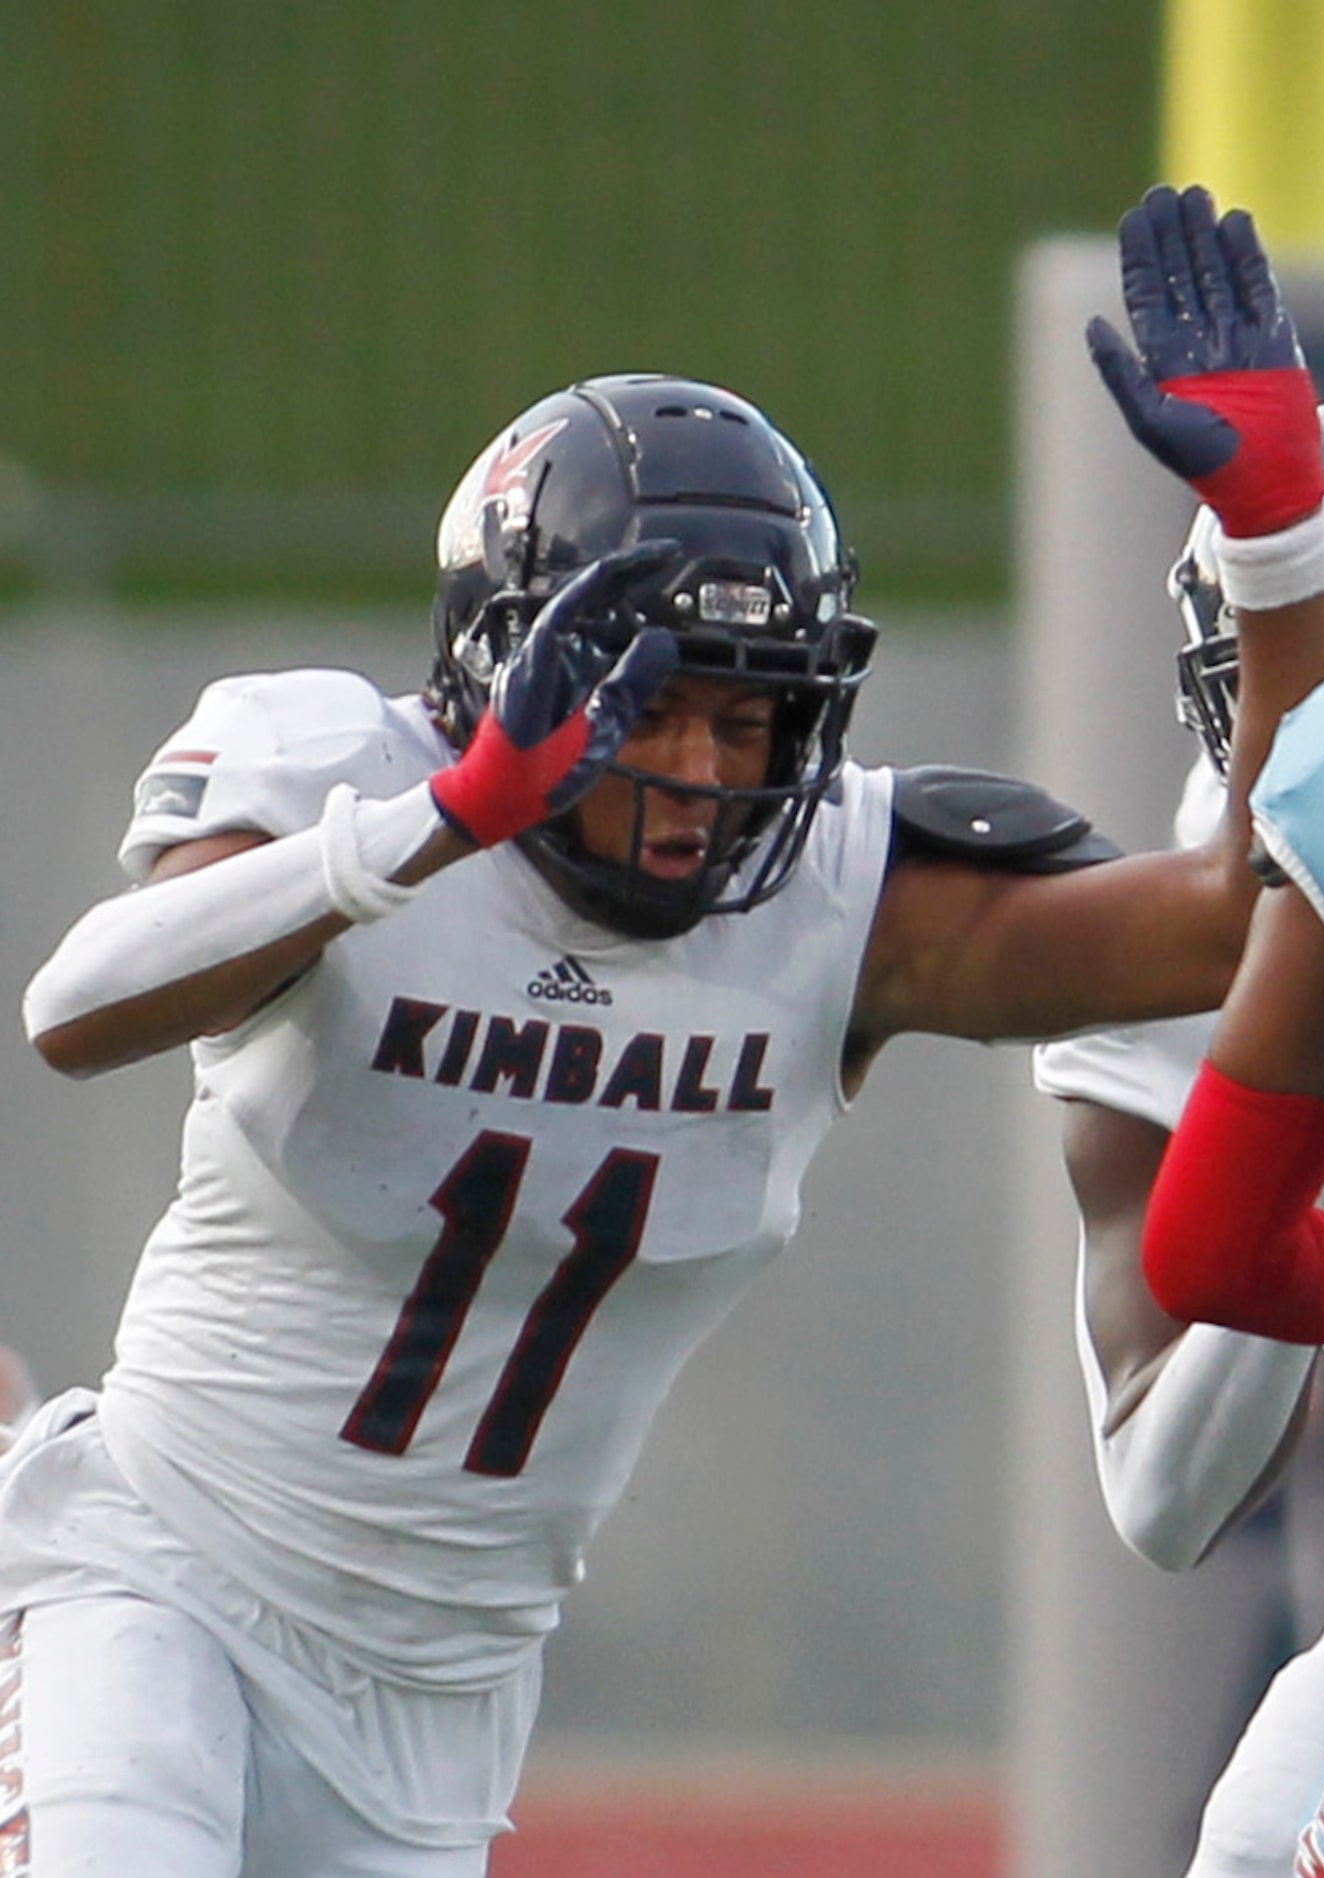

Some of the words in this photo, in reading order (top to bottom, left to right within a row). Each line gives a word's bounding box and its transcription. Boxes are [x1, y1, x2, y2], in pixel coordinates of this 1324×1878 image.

[527, 980, 614, 1007] adidas
[370, 996, 775, 1112] KIMBALL
[338, 1128, 661, 1479] 11
